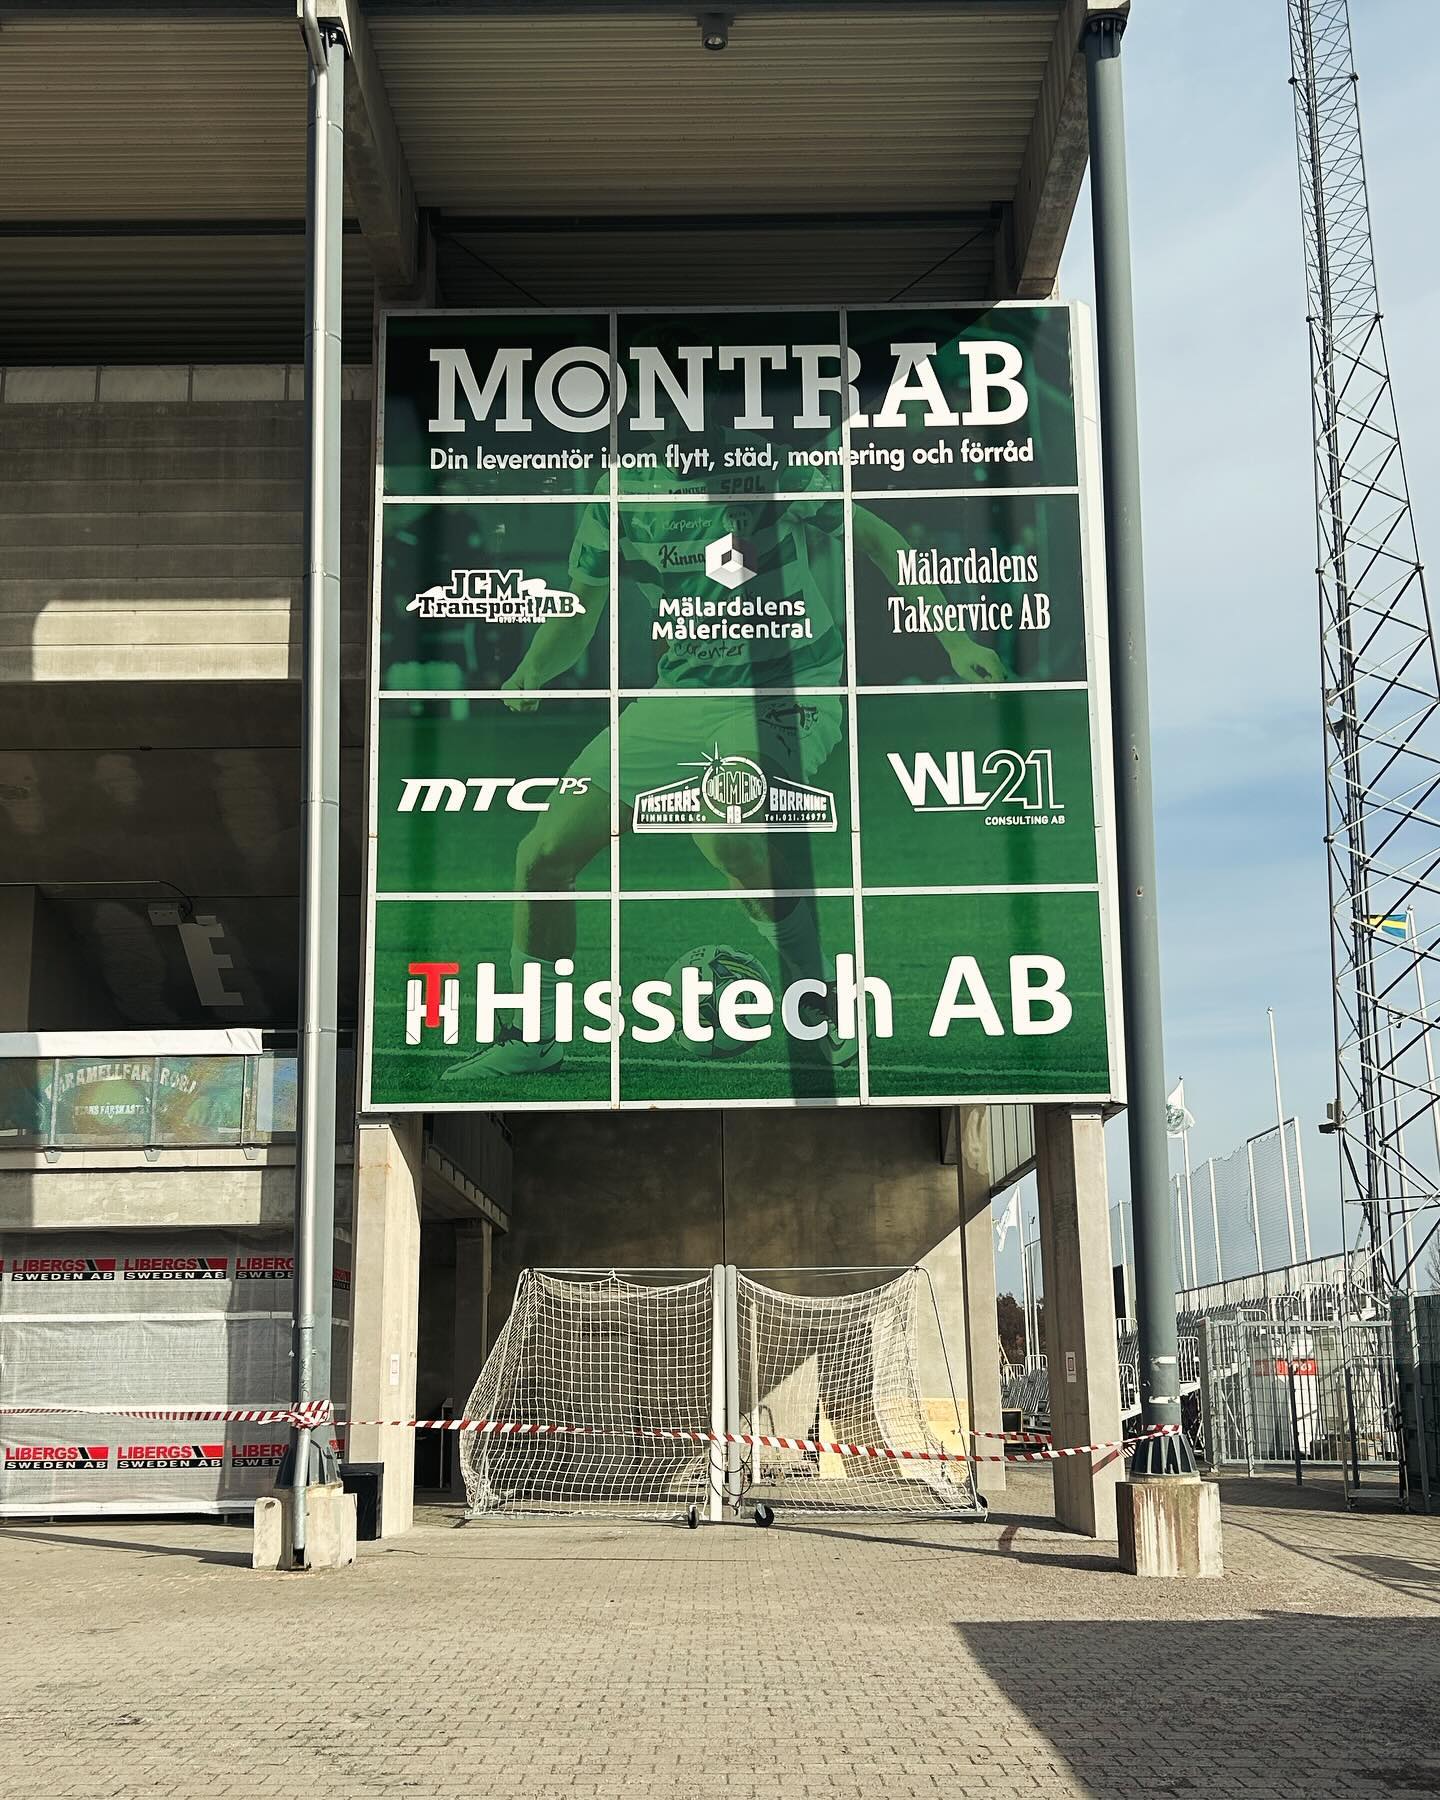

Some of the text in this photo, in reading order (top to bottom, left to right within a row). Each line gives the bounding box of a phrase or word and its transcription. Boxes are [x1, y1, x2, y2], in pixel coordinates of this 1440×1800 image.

[429, 341, 1029, 433] MONTRAB
[430, 447, 468, 470] Din
[477, 446, 593, 470] leverantör
[665, 444, 715, 475] flytt,
[723, 443, 779, 471] städ,
[788, 442, 905, 472] montering
[912, 440, 953, 464] och
[961, 437, 1034, 464] förråd
[896, 547, 1039, 586] Mälardalens
[446, 572, 521, 599] JCM
[418, 596, 575, 619] Transport AB
[659, 596, 806, 617] Mälardalens
[887, 593, 1051, 634] Takservice AB
[652, 617, 813, 640] Målericentral
[559, 777, 592, 795] PS
[641, 786, 700, 812] VÄSTERÅS
[770, 786, 827, 811] BORRNING
[985, 815, 1066, 826] CONSULTING AB
[476, 953, 1073, 1044] Hisstech AB
[12, 1259, 86, 1272] LIBERGS
[124, 1258, 198, 1270] LIBERGS
[91, 1272, 113, 1280] AB
[125, 1271, 225, 1280] SWEDEN AB
[5, 1447, 78, 1460] LIBERGS
[117, 1445, 192, 1459] LIBERGS
[6, 1461, 107, 1469] SWEDEN AB
[119, 1459, 221, 1468] SWEDEN AB
